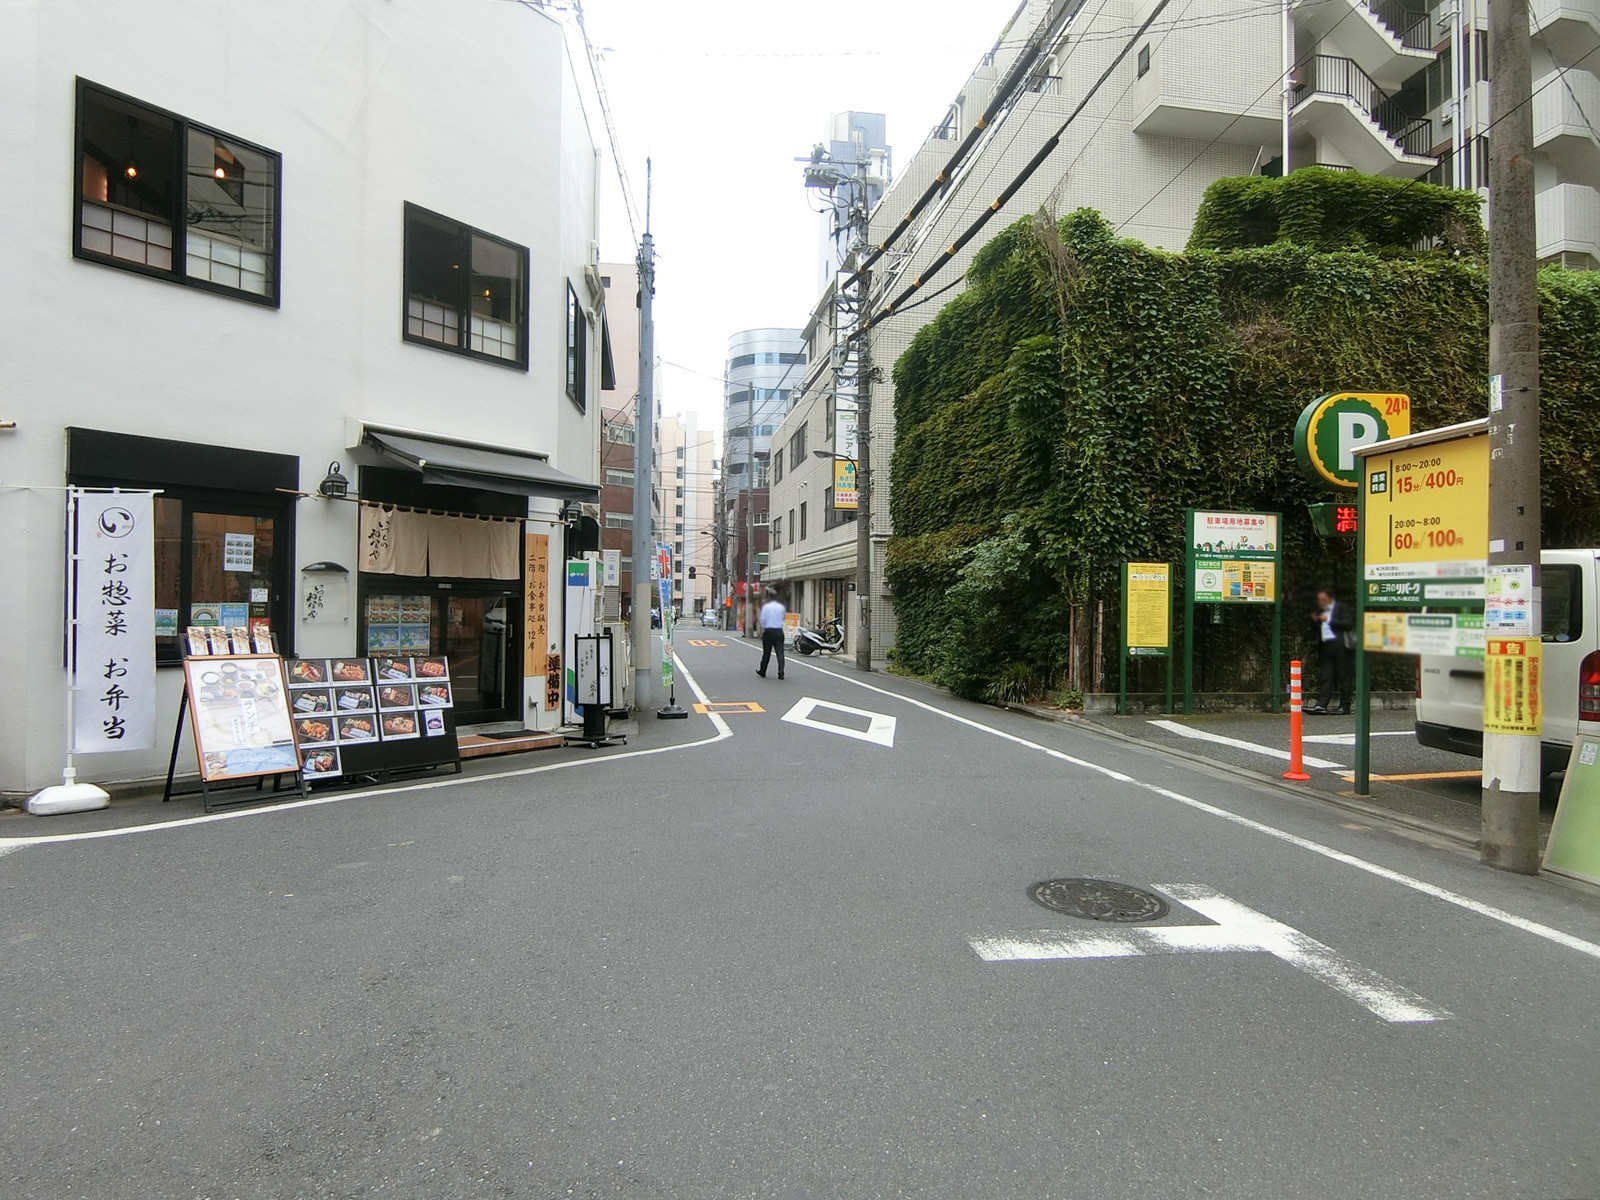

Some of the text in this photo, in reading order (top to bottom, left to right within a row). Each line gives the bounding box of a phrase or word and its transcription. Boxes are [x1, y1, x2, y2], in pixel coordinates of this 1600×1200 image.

[1385, 397, 1408, 416] 24h
[1338, 412, 1379, 471] P
[1396, 469, 1464, 494] 15分/400円
[1207, 516, 1265, 526] 駐車場用地募集中
[1394, 529, 1464, 550] 60分/100円
[528, 554, 537, 573] 二階
[537, 556, 546, 636] 一階 お弁当販売
[1380, 582, 1421, 595] 三井のリパーク
[527, 581, 537, 623] お食事処
[100, 553, 132, 740] お惣菜 お弁当
[1489, 642, 1521, 654] 警告
[547, 655, 561, 708] 準備中
[243, 700, 258, 734] ランチ
